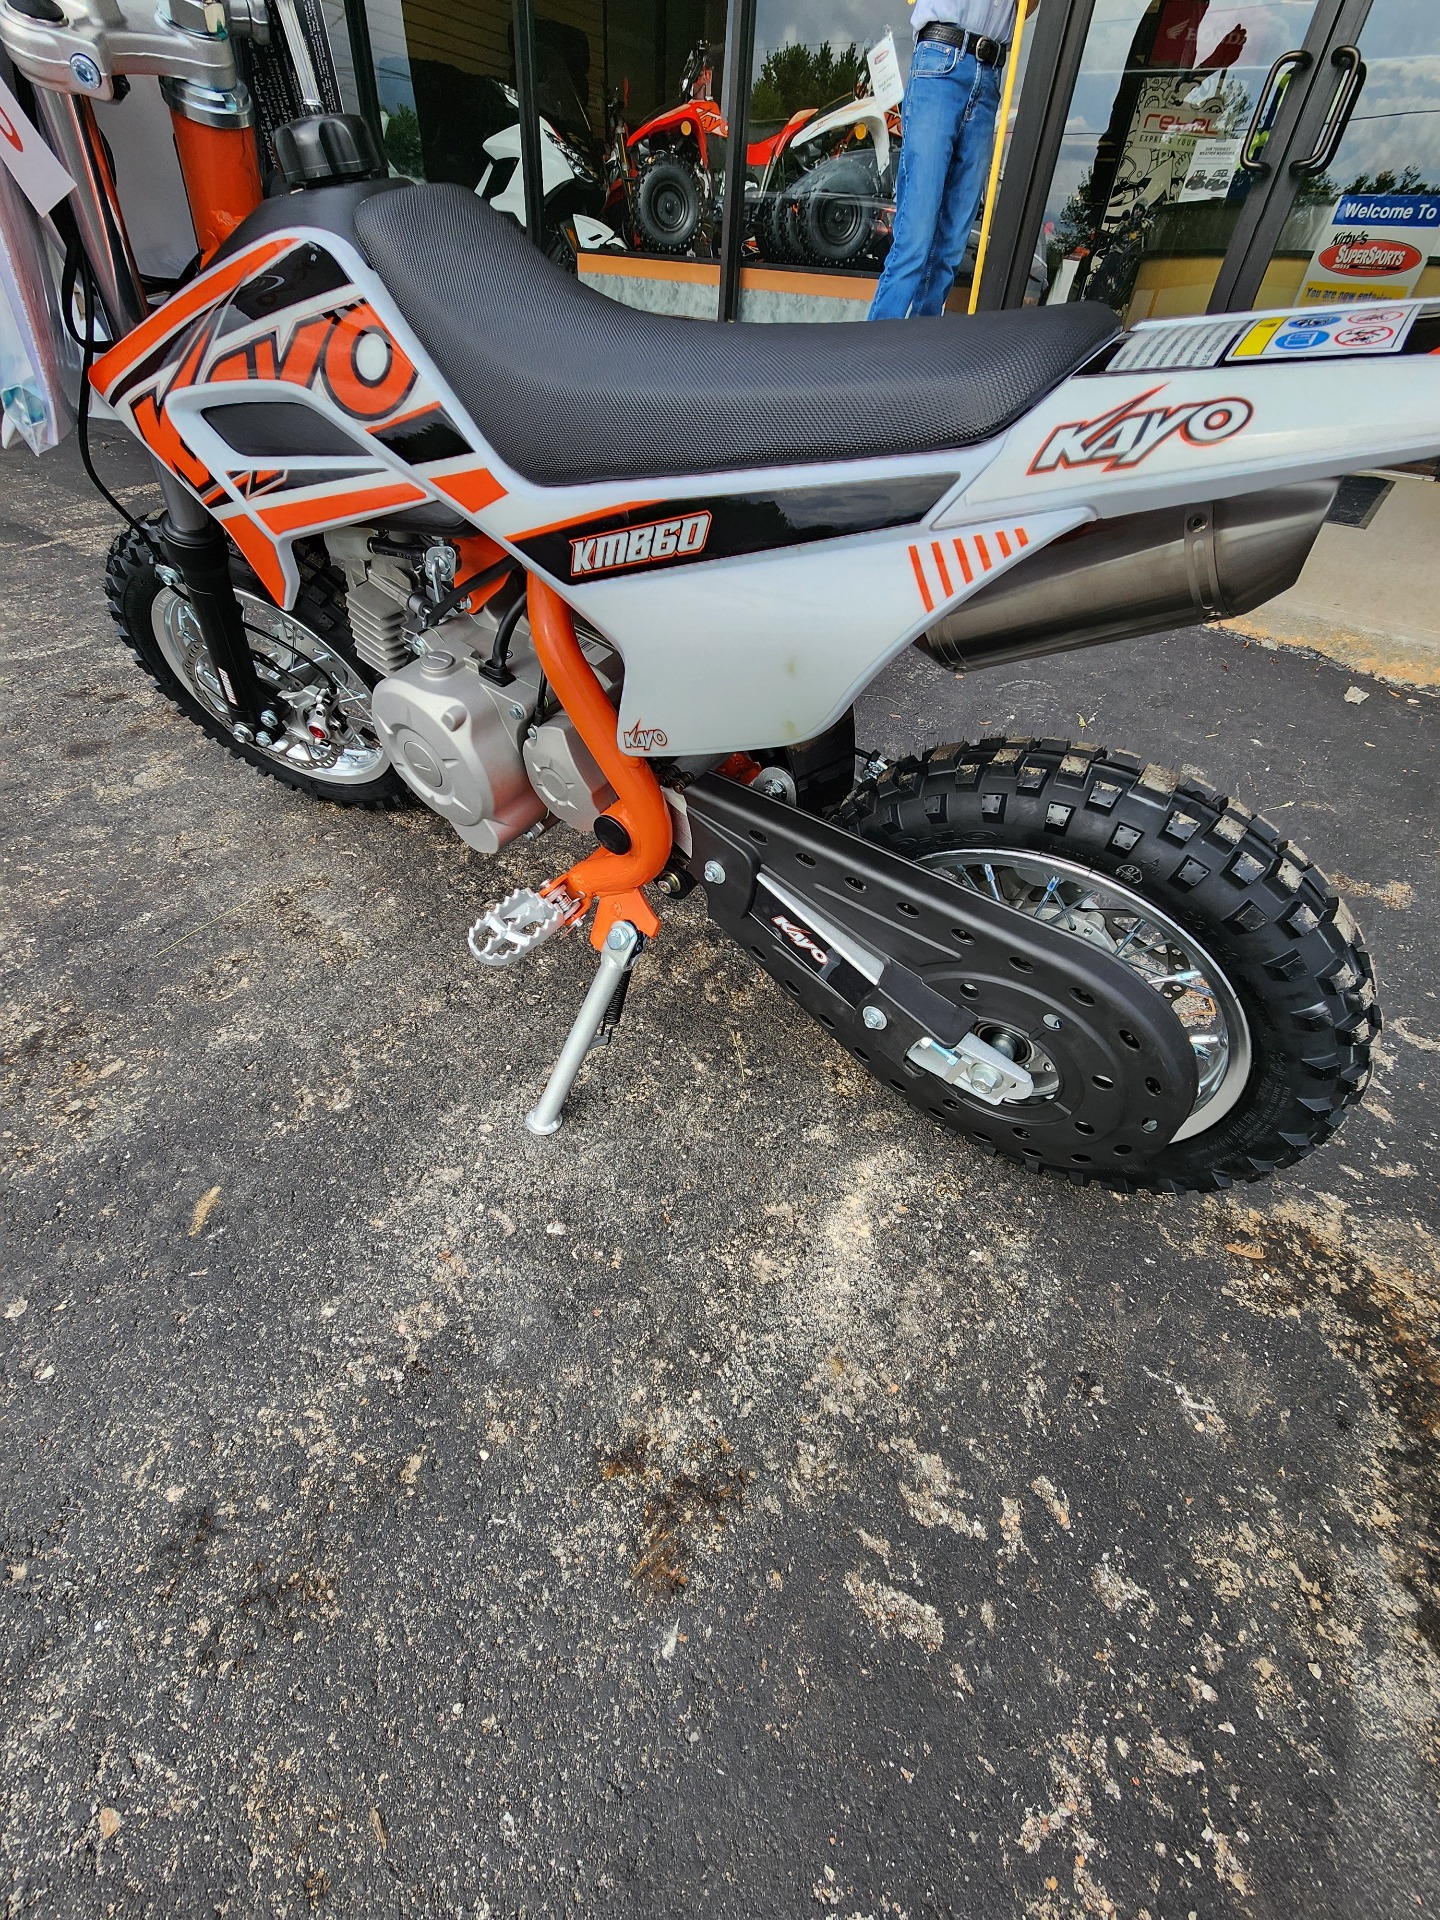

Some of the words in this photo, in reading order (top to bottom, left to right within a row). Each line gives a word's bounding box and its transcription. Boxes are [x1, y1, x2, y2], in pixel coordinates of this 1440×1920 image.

[1344, 202, 1414, 219] Welcome
[1417, 203, 1438, 220] To
[1330, 230, 1370, 249] Kirby's
[1306, 287, 1322, 298] You
[1322, 290, 1337, 300] are
[1338, 290, 1357, 302] now
[1026, 381, 1254, 476] KAYO
[570, 511, 712, 576] KMB60
[624, 719, 667, 751] KAYO
[771, 915, 829, 965] KAYO
